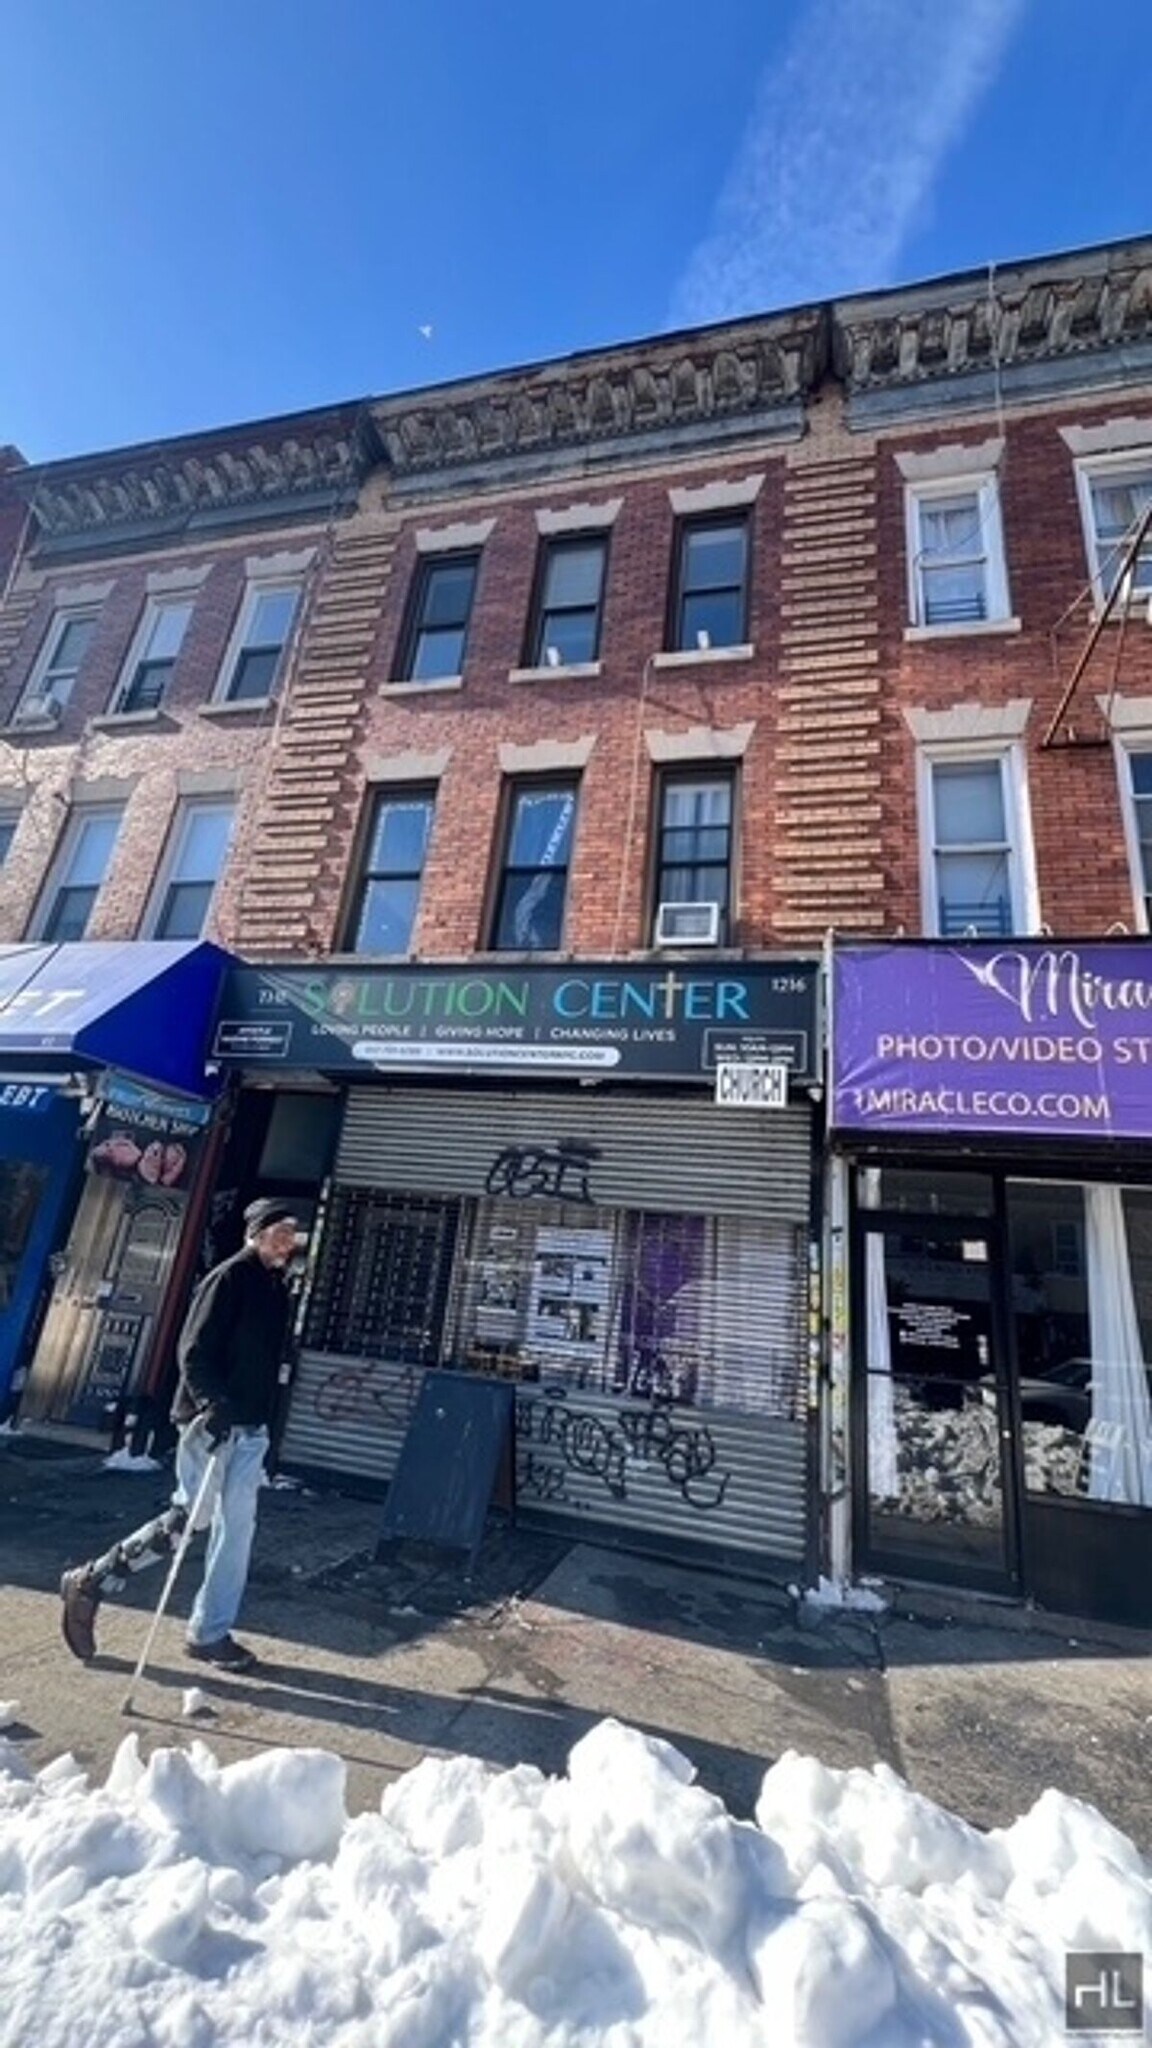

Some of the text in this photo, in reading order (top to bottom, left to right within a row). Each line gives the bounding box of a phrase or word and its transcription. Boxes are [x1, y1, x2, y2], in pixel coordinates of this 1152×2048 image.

[552, 971, 750, 1019] CENTER
[362, 1024, 412, 1038] PEOPLE
[435, 1024, 524, 1040] GIVING HOPE
[550, 1026, 677, 1043] CHANGING LIVES
[876, 1034, 1152, 1065] PHOTO/VIDEO ST
[721, 1066, 783, 1103] CHURCH
[0, 1085, 49, 1107] EBT
